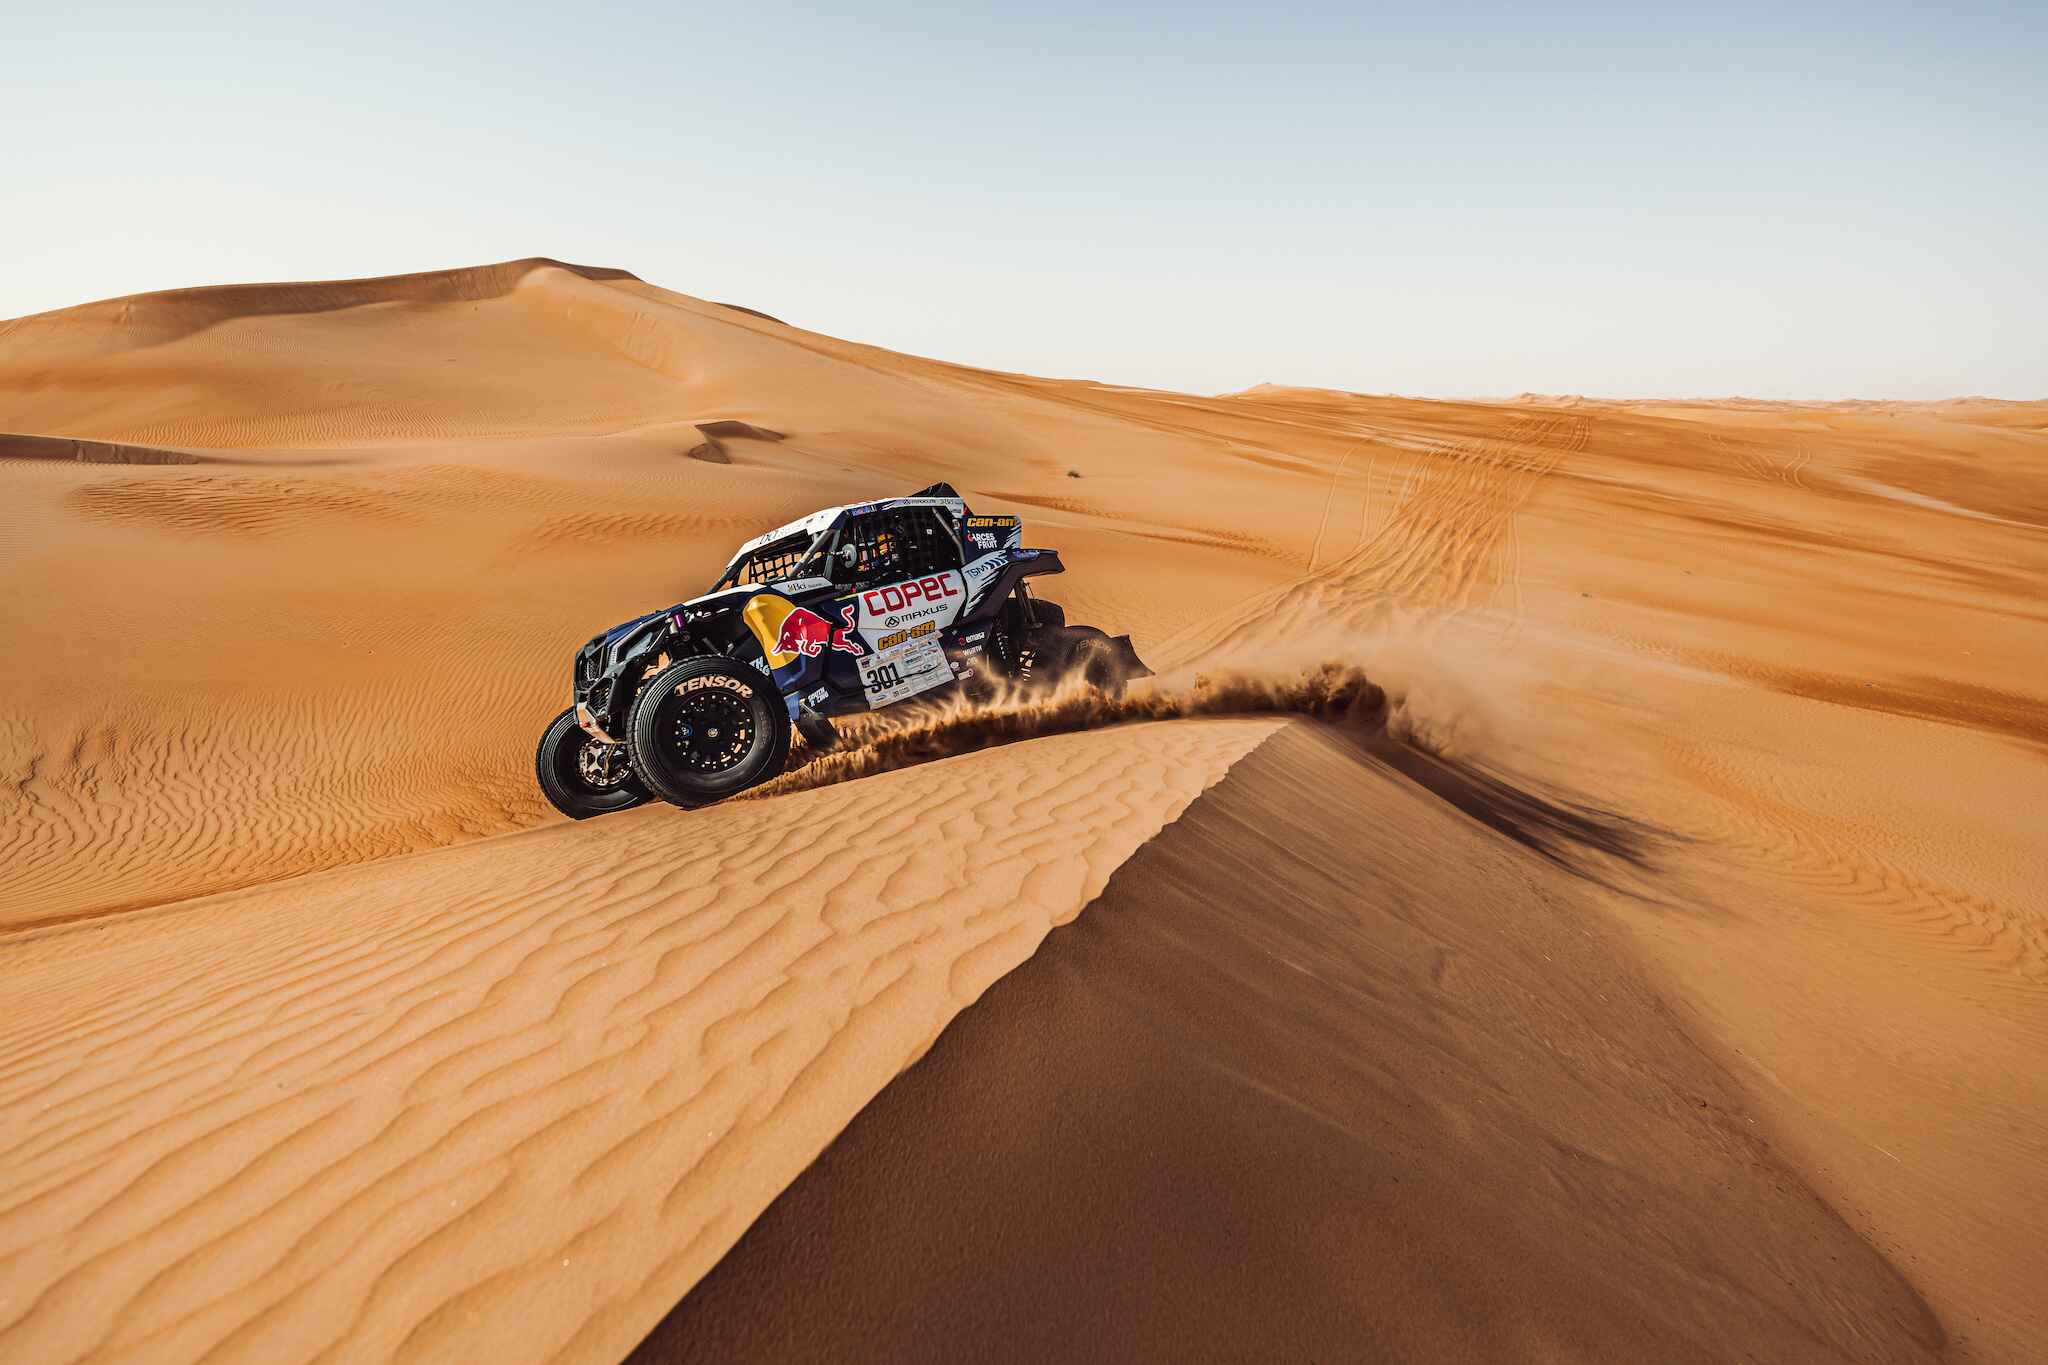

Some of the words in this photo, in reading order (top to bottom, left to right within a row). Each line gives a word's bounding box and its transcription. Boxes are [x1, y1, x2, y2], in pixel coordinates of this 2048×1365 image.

[967, 517, 1016, 528] can-am
[977, 540, 998, 549] FRUIT
[901, 604, 949, 622] MAXUS
[878, 620, 936, 651] can-am
[674, 675, 753, 699] TENSOR
[866, 662, 905, 694] 301
